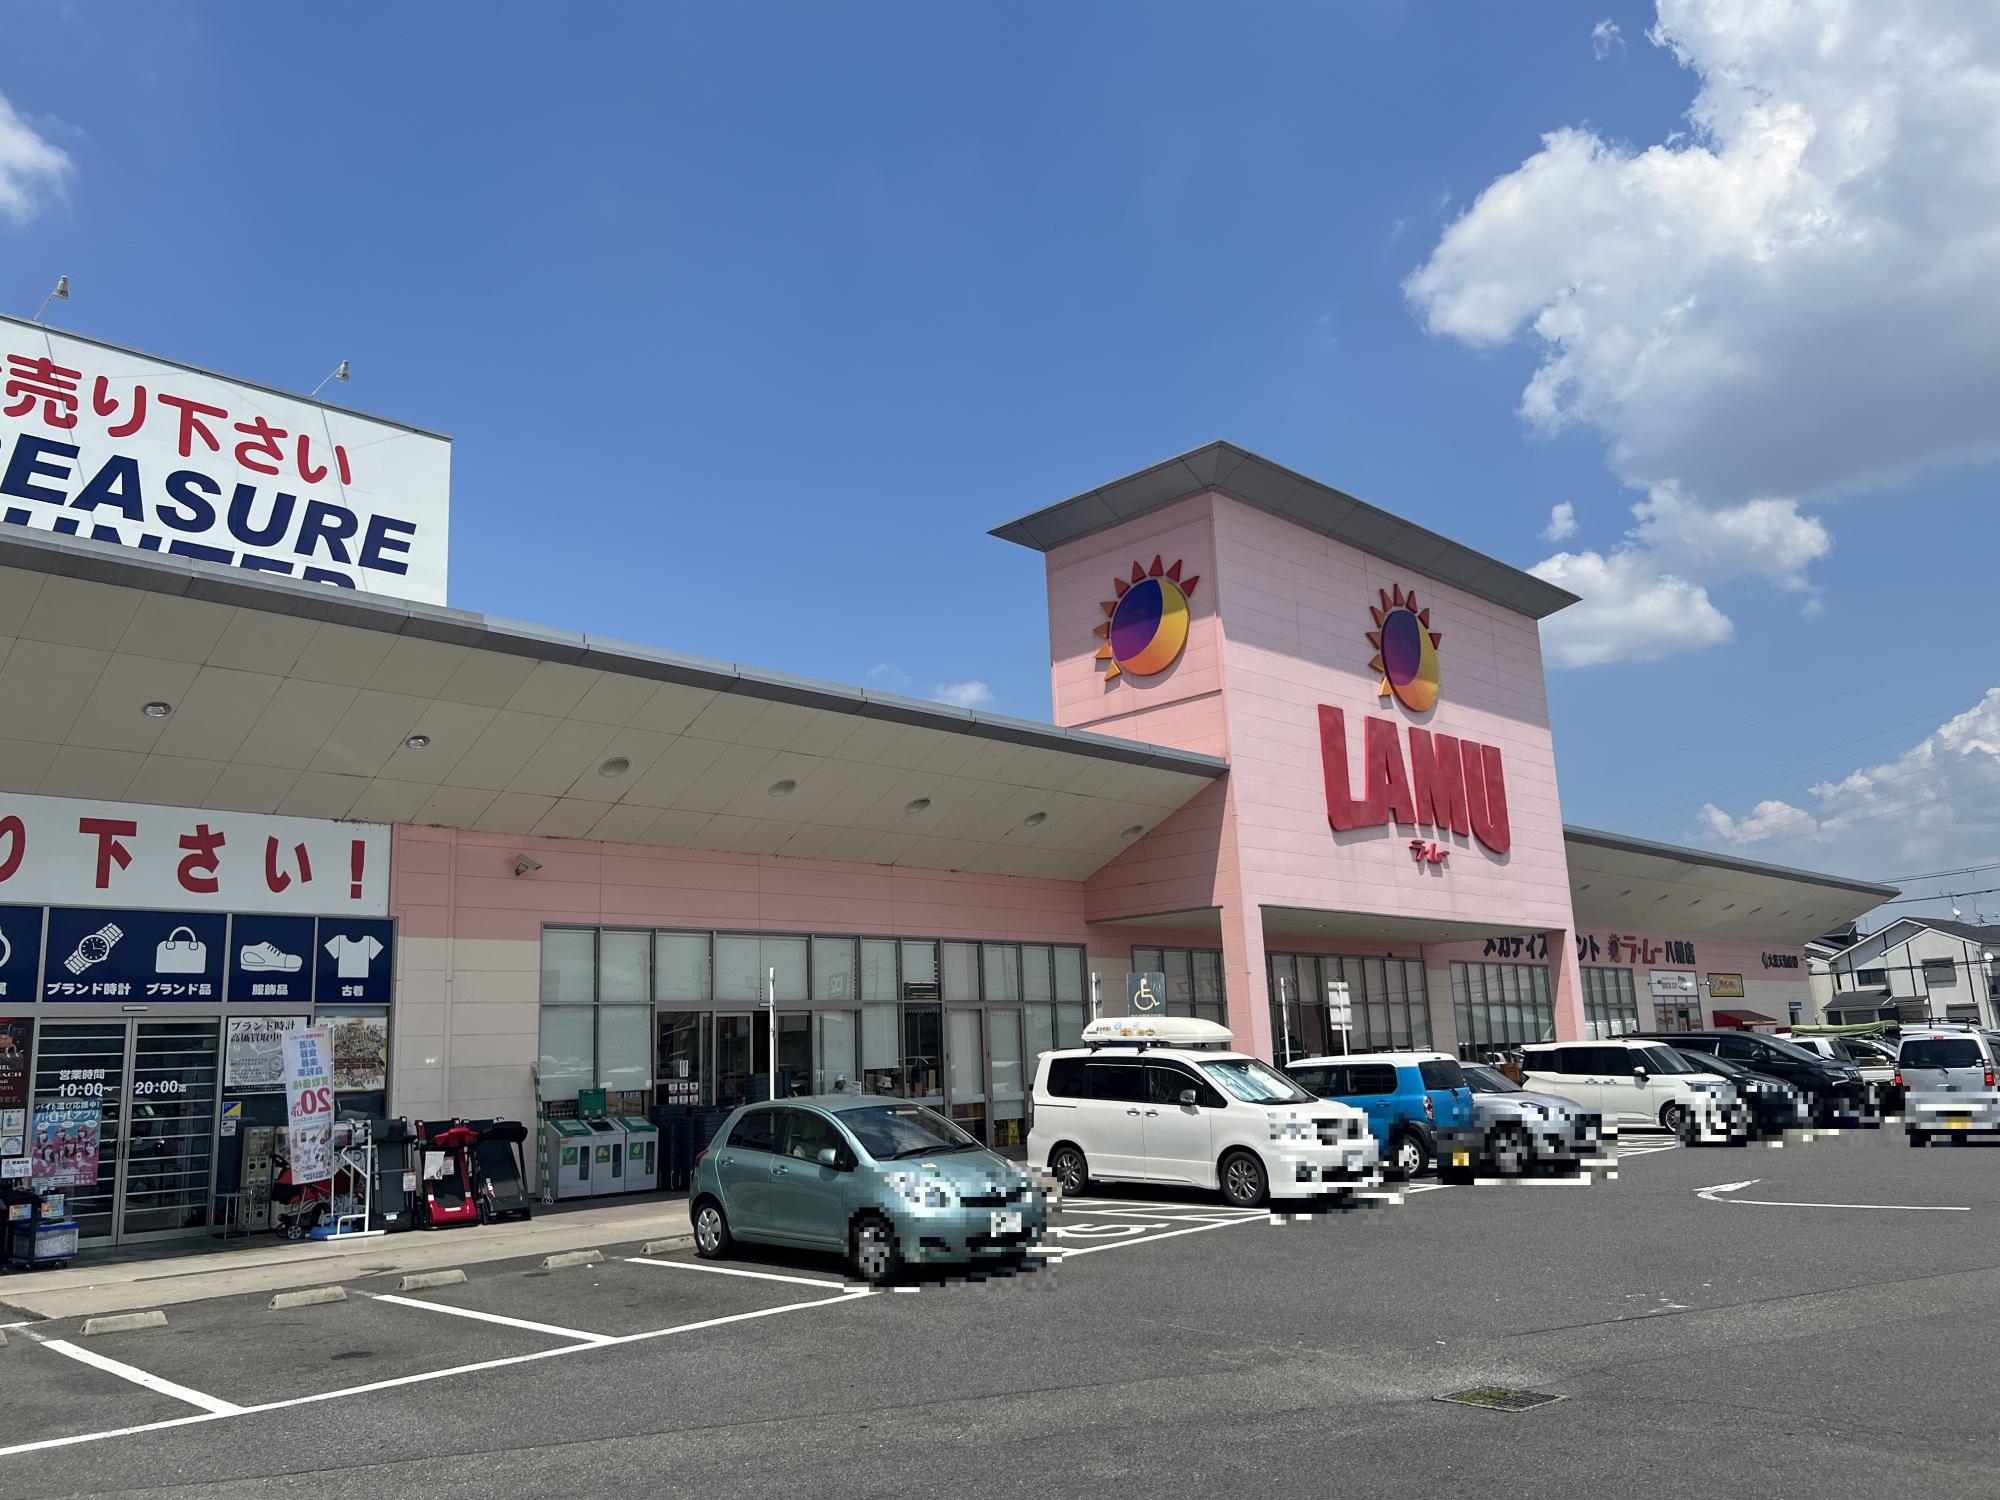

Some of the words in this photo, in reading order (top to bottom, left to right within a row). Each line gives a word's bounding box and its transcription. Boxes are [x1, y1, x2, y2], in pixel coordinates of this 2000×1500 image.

[0, 352, 352, 485] 売り下さい
[0, 433, 417, 576] EASURE
[1318, 703, 1511, 854] LAMU
[47, 982, 132, 996] ブランド時計
[146, 983, 212, 996] ブランド品
[252, 983, 289, 996] 服飾品
[341, 985, 364, 997] 古着
[231, 1020, 296, 1032] ブランド時計
[59, 1069, 105, 1081] 営業時間
